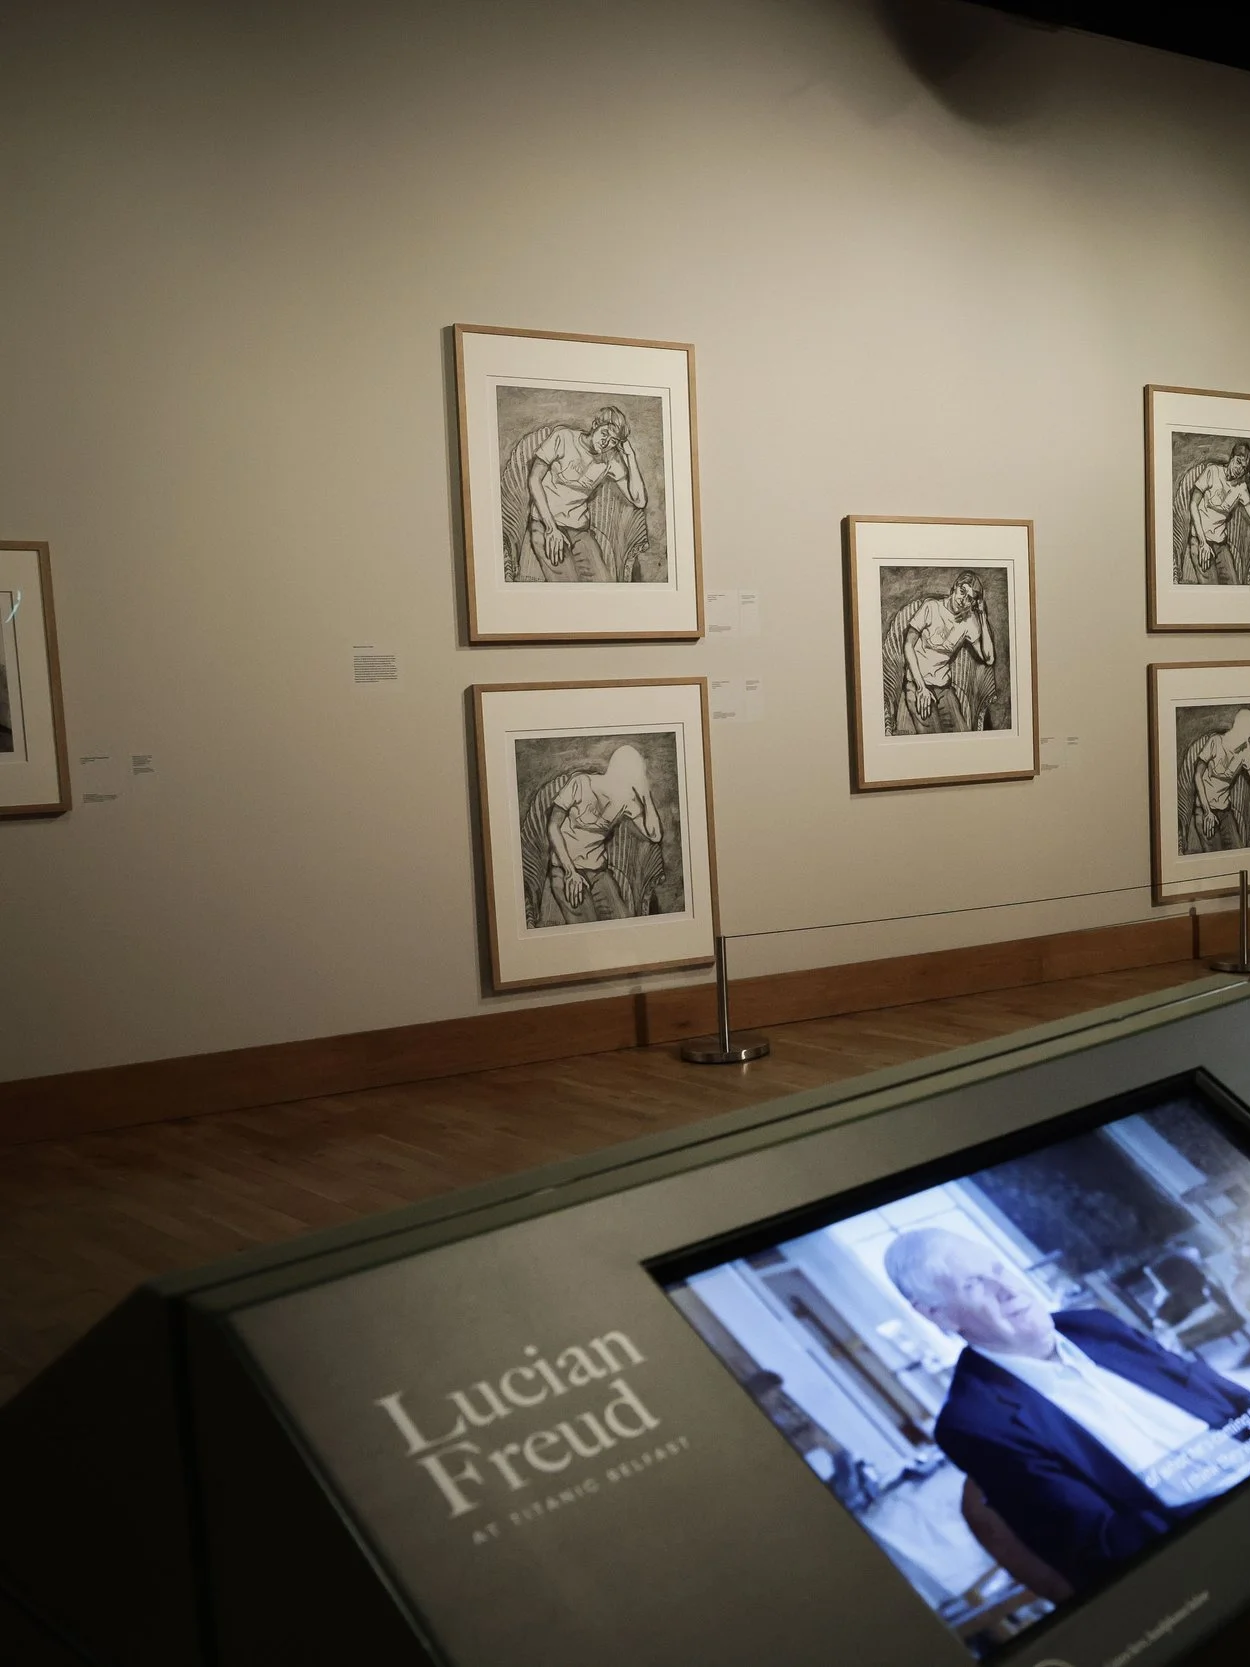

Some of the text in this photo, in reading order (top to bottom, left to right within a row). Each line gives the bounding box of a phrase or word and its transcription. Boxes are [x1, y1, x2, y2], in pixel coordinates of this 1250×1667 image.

[374, 1329, 647, 1457] Lucian
[416, 1377, 662, 1519] Freud
[472, 1521, 500, 1546] AT
[605, 1435, 690, 1484] BELFAST
